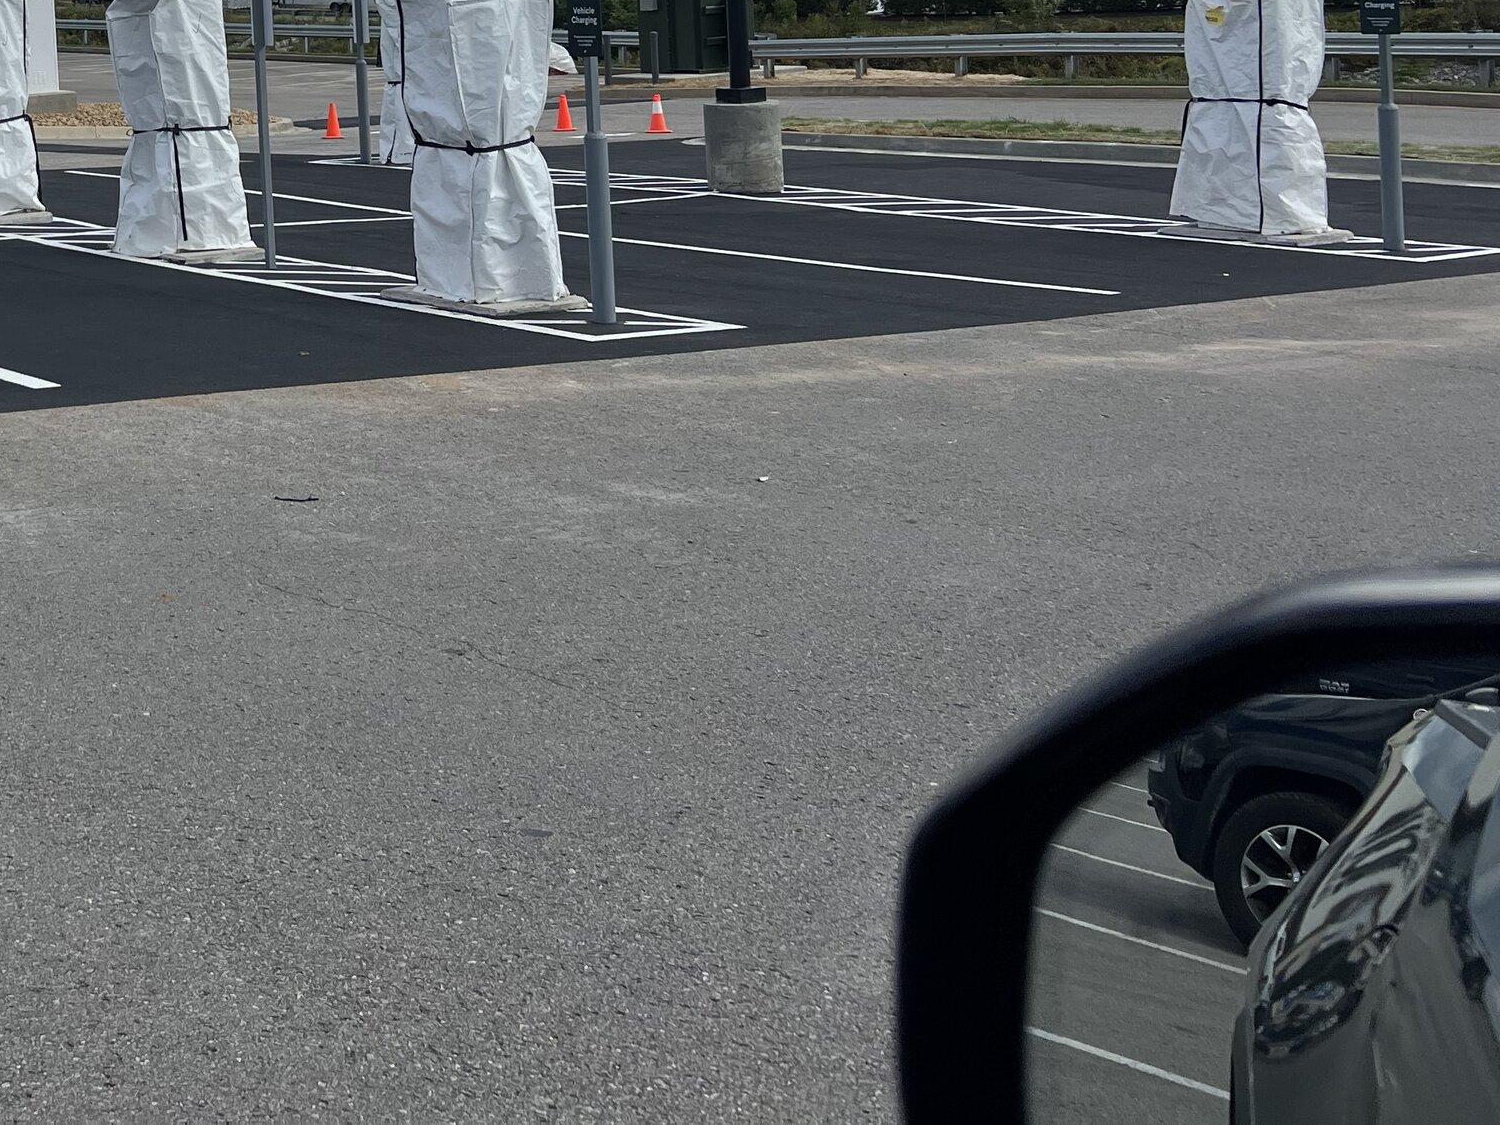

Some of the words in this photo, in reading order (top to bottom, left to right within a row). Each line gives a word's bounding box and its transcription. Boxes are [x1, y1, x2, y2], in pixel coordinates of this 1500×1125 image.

[572, 6, 595, 14] Vehicle
[1364, 2, 1395, 10] Charging
[571, 16, 597, 25] Charging
